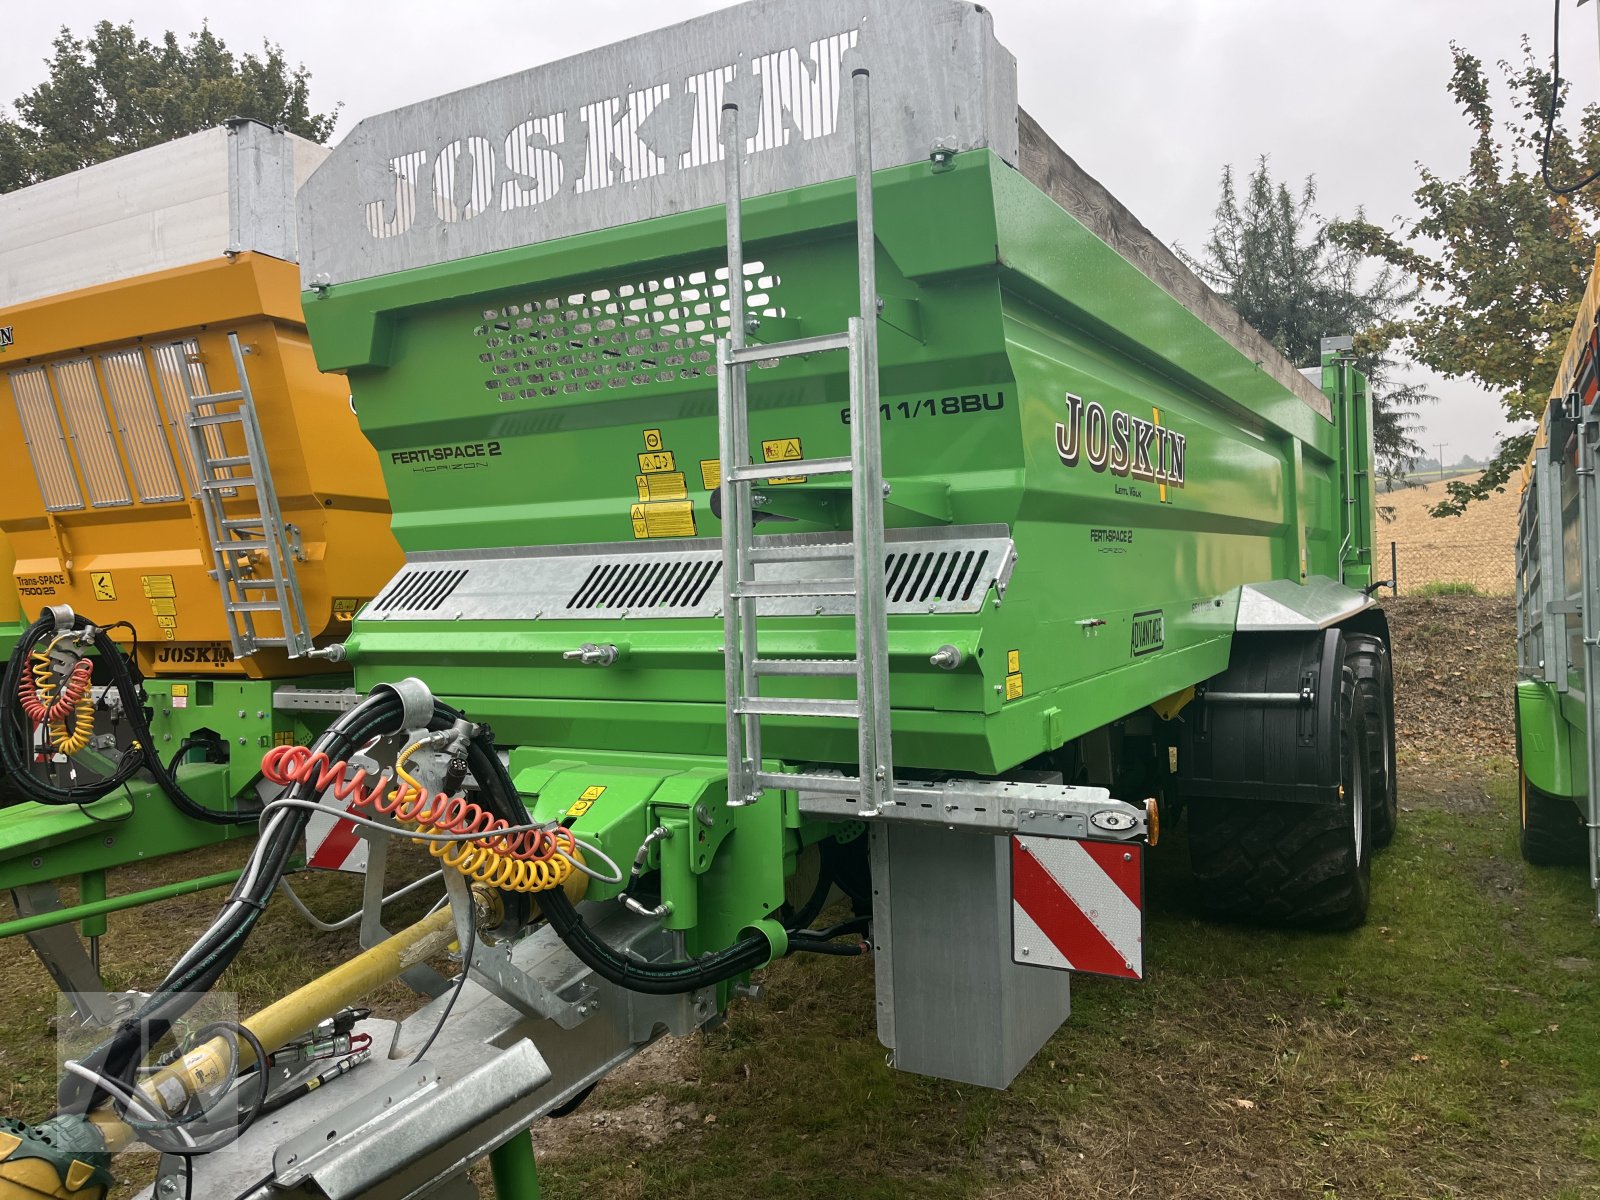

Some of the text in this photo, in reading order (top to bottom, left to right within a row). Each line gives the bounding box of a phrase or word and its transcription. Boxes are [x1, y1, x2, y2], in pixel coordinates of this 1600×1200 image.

[366, 30, 860, 239] JOSKIN
[841, 393, 1004, 425] 611/18BU
[391, 441, 503, 465] FERTI-SPACE 2
[1056, 394, 1186, 487] JOSKIN
[412, 462, 489, 473] HORIZON
[1090, 529, 1133, 544] FERTI-SPACE 2
[1130, 617, 1162, 656] ADVANTAGE
